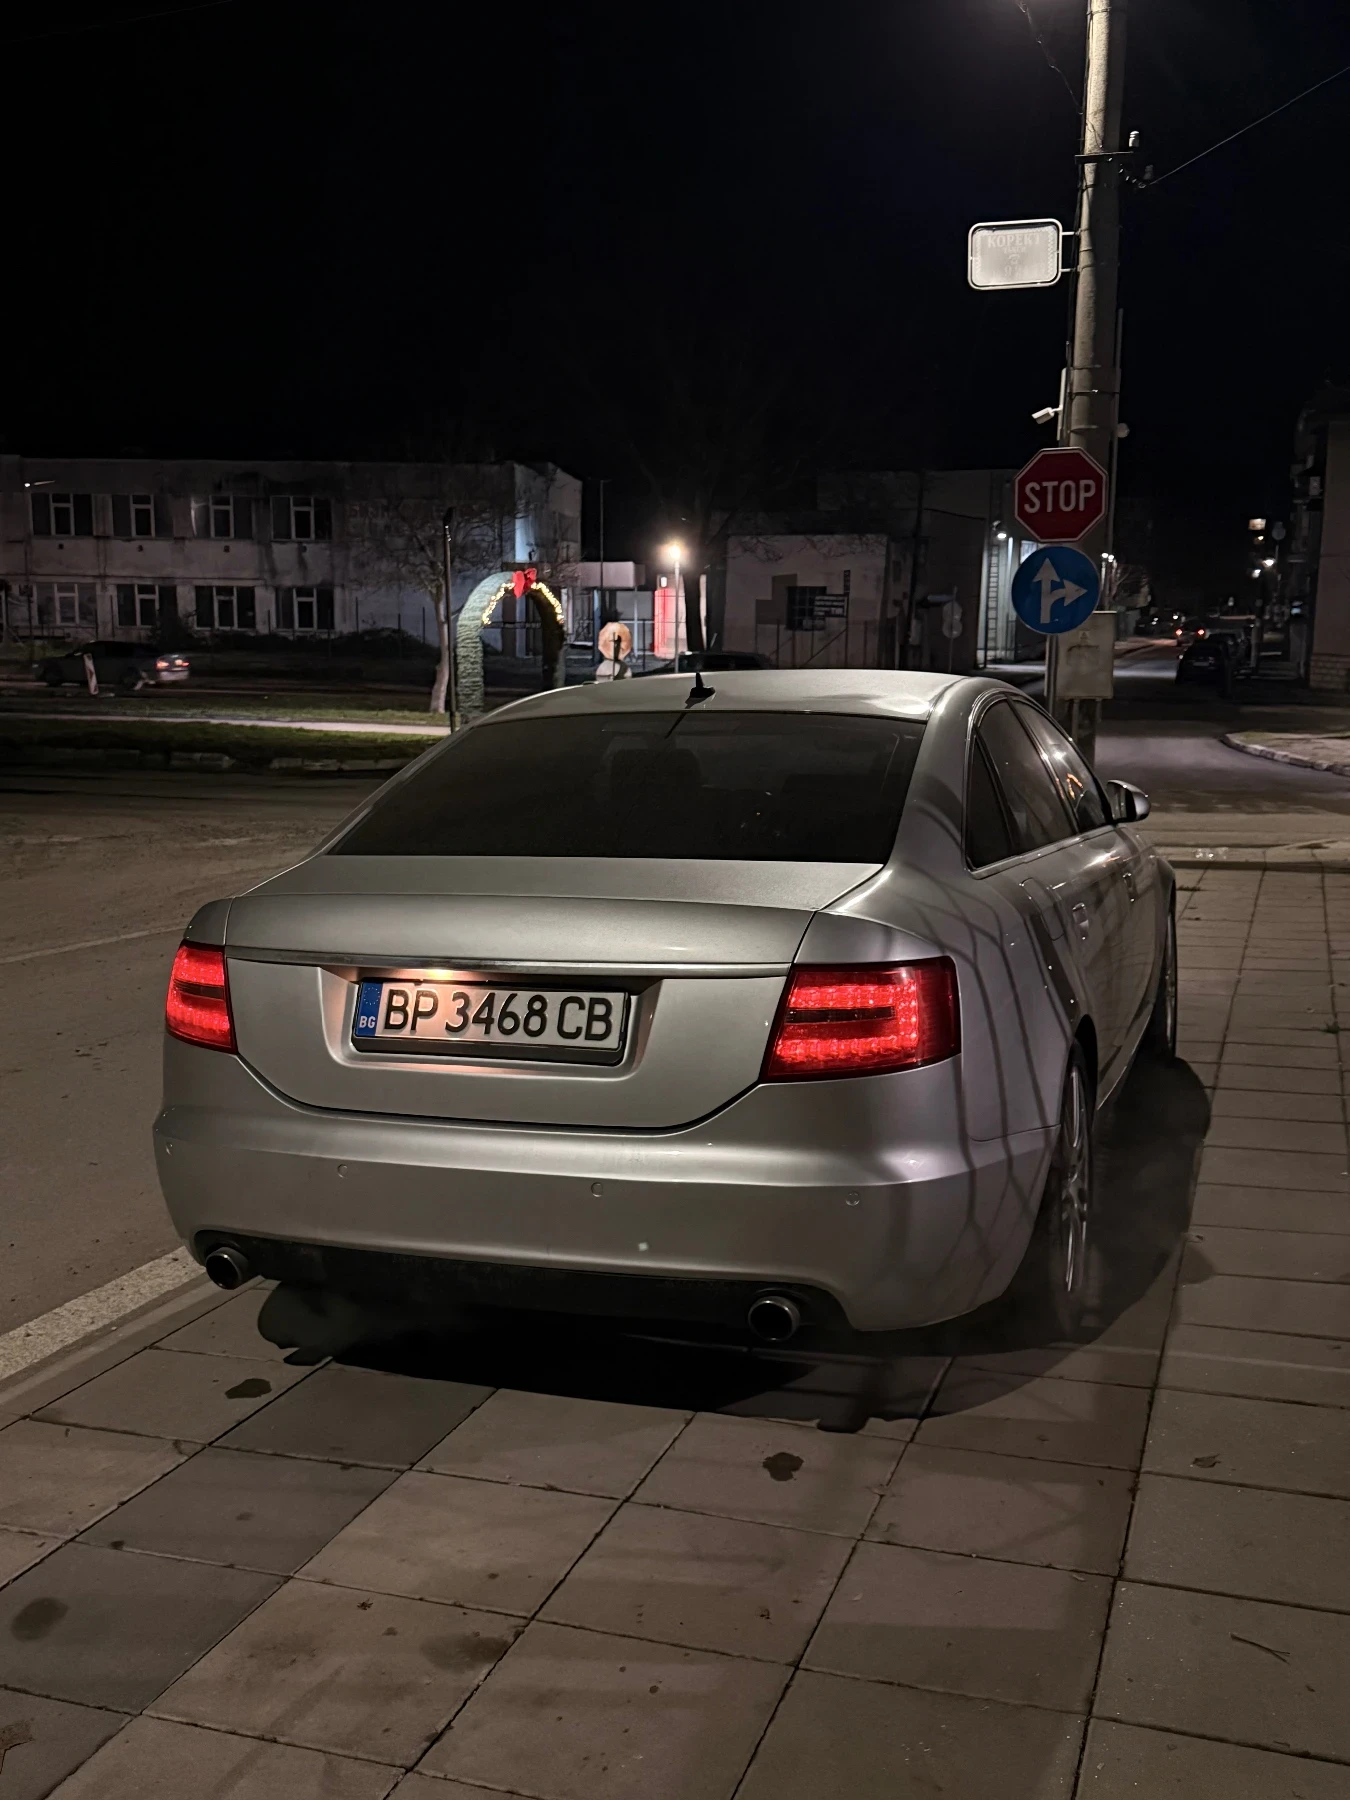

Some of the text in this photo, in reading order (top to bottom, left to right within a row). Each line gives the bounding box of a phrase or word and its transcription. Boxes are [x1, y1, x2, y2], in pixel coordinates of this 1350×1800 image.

[1023, 479, 1096, 514] STOP
[359, 1015, 376, 1029] BG
[384, 988, 614, 1042] BP 3468 CB
